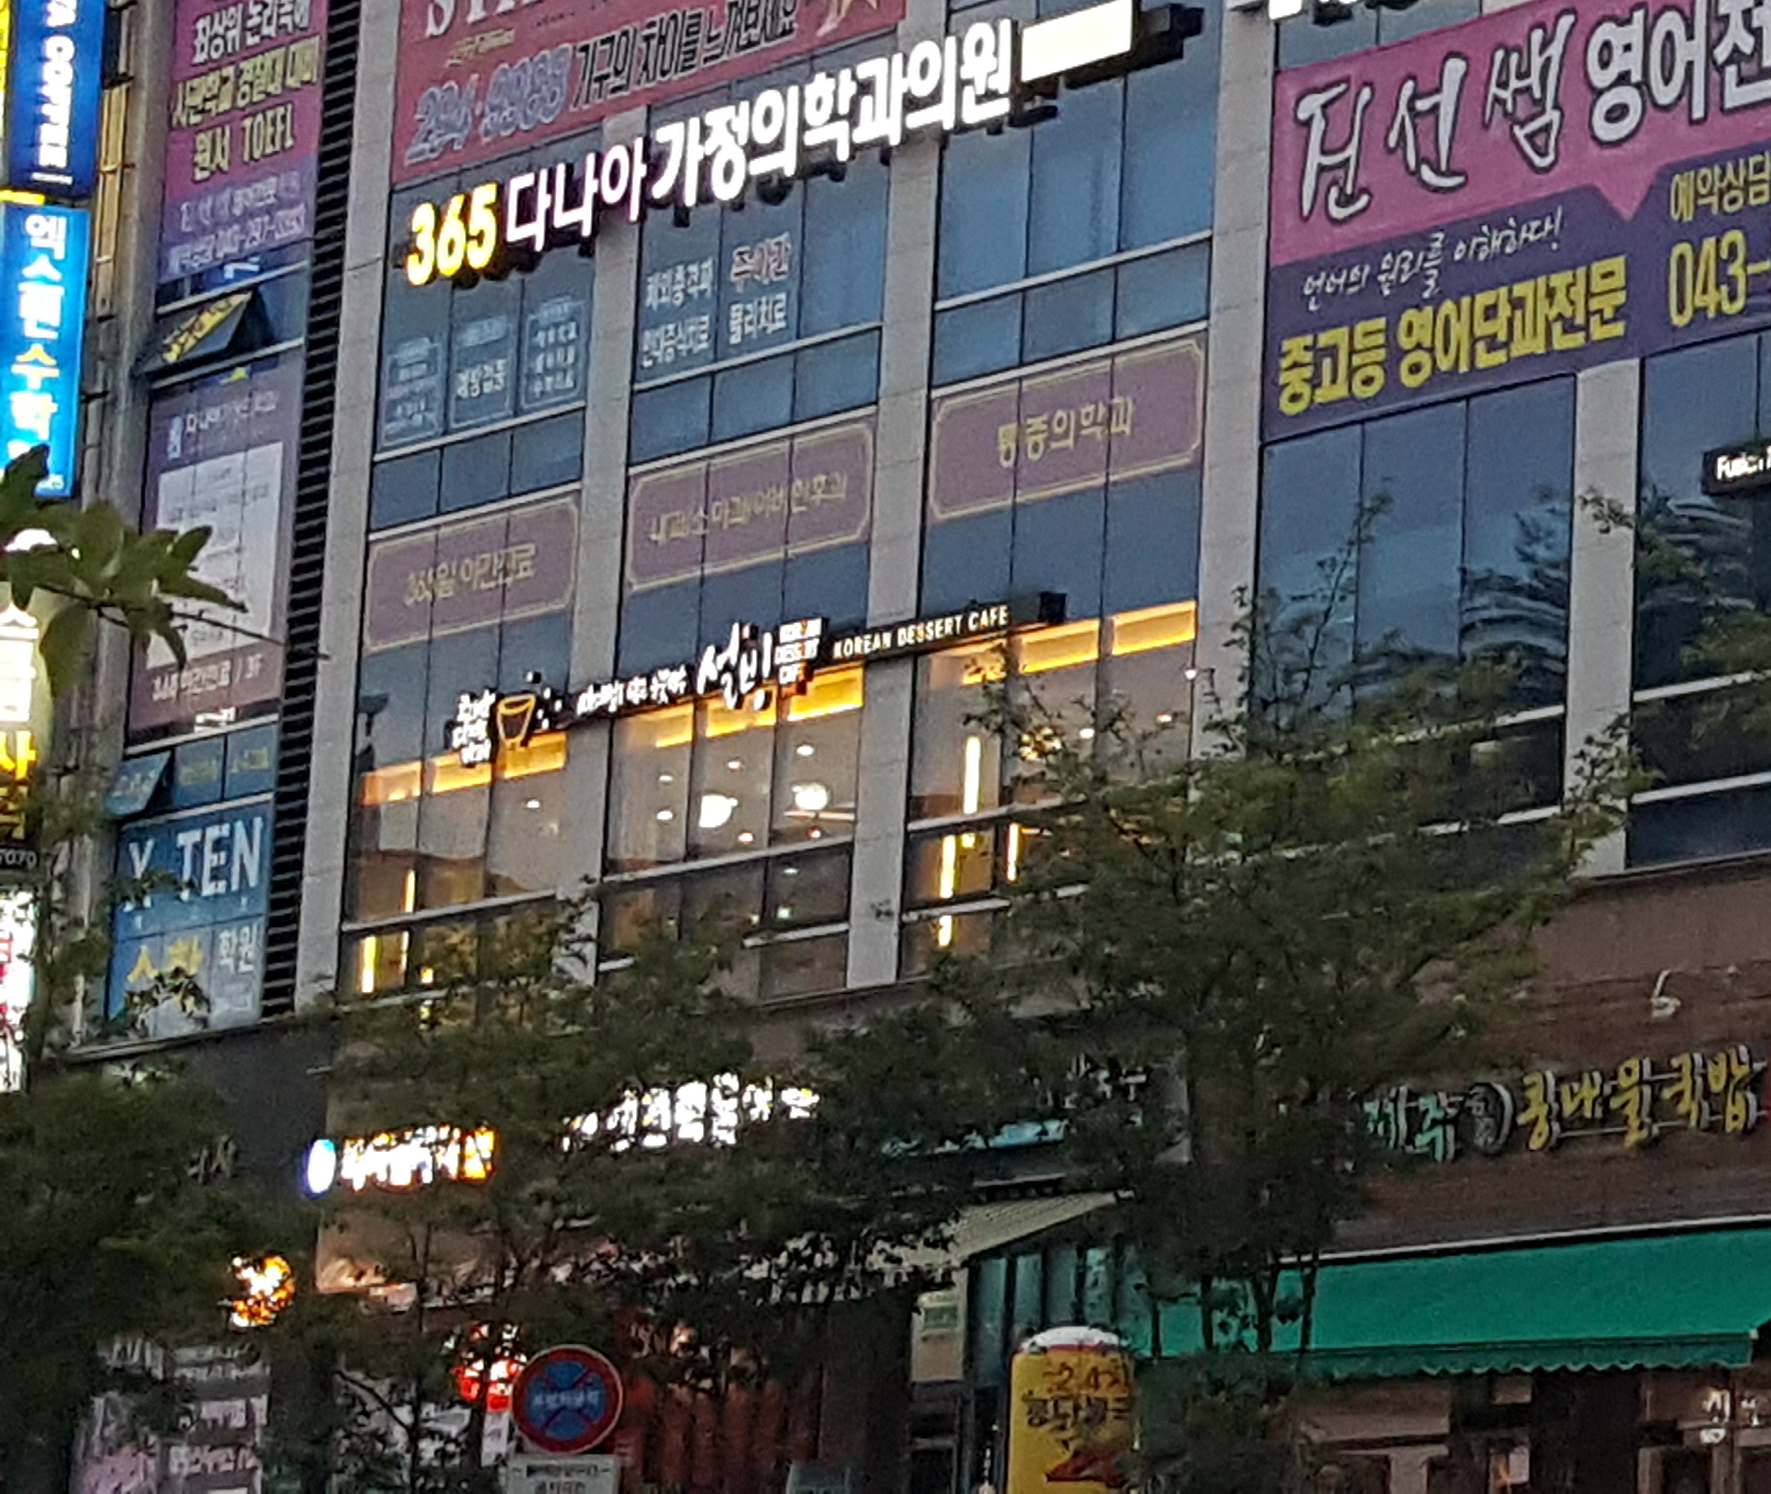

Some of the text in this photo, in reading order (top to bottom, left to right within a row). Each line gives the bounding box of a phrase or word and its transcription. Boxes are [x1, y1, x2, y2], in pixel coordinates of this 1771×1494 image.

[239, 101, 297, 165] TOEFL
[1668, 150, 1771, 224] 예약상담
[405, 182, 499, 288] 365
[1277, 254, 1628, 416] 중고등 영어단과전문
[832, 604, 1010, 660] KOREAN DESSERT CAFE
[176, 816, 264, 904] TEN
[217, 921, 259, 976] 학원
